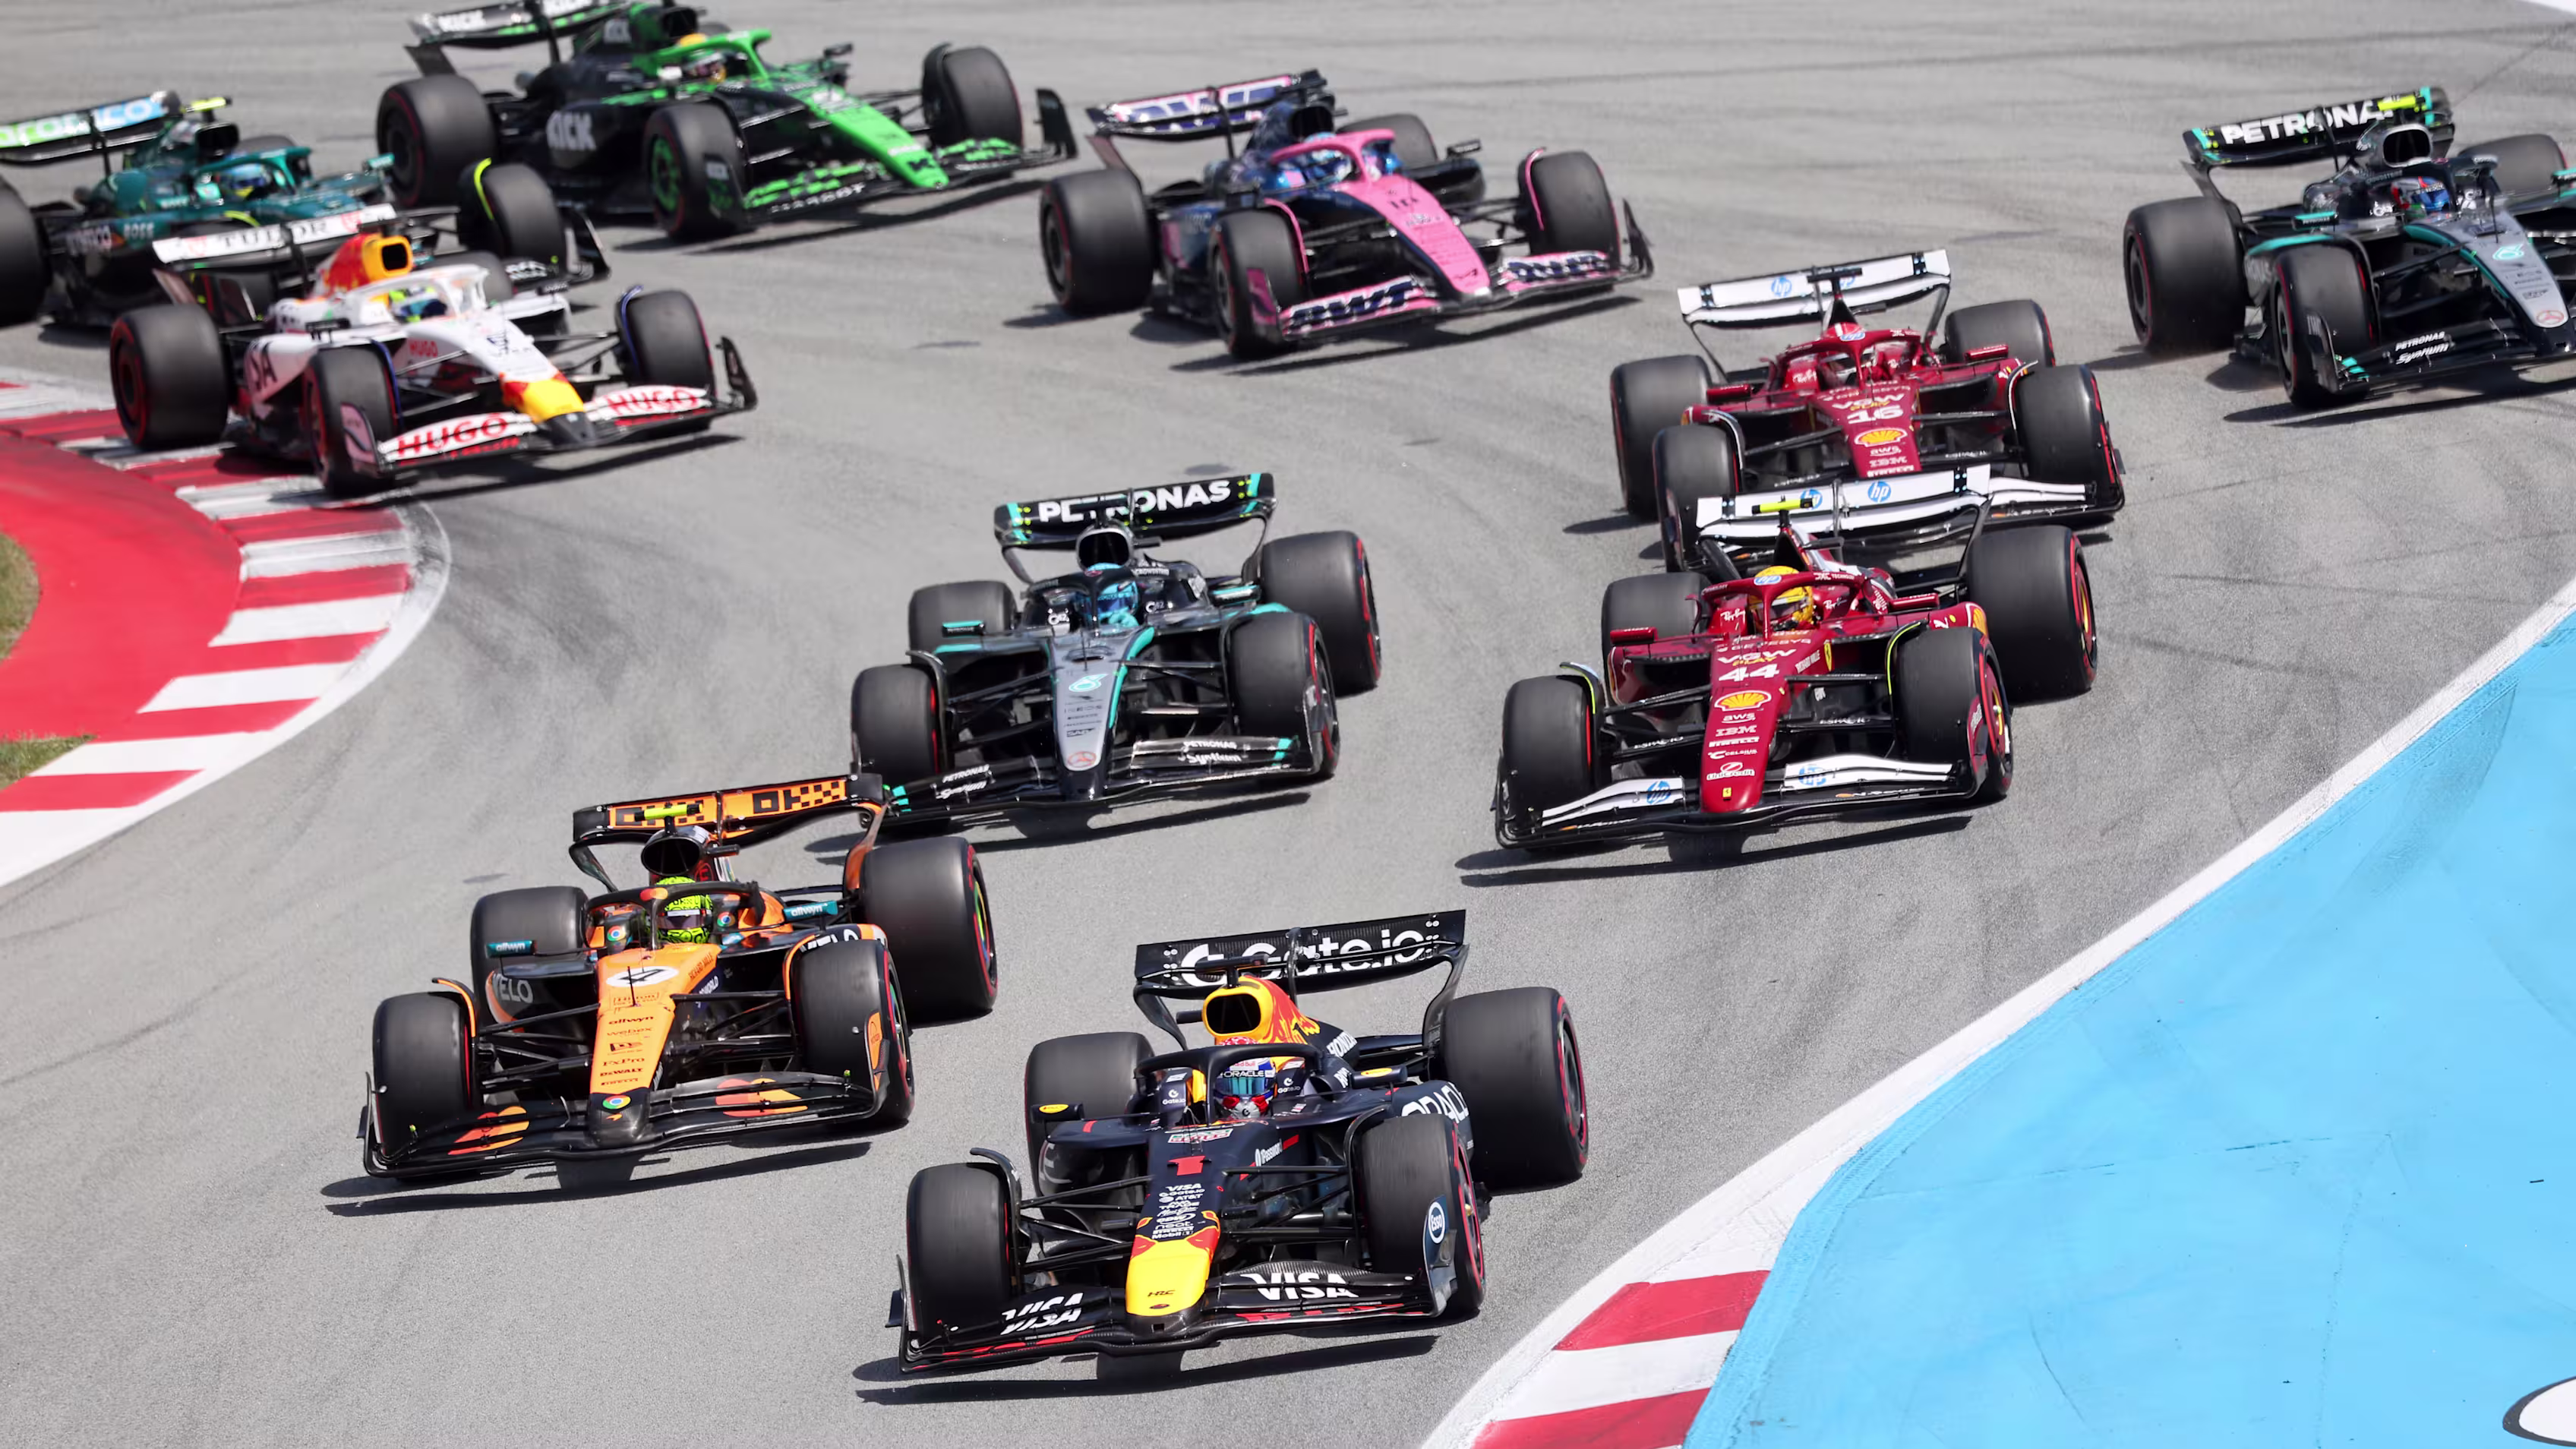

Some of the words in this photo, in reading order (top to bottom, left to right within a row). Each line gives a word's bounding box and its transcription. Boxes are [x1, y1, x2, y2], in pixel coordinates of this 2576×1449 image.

[2395, 331, 2445, 352] PETRONAS
[1846, 405, 1904, 424] 16
[395, 412, 509, 456] HUGO
[1867, 481, 1892, 503] hp
[1717, 649, 1797, 664] VGW
[1718, 663, 1779, 681] 44
[1722, 712, 1756, 721] aws
[1715, 724, 1757, 737] IBM
[1183, 741, 1237, 750] PETRONAS
[1186, 752, 1242, 765] Syntium
[942, 763, 990, 783] PETRONAS
[495, 942, 526, 952] allwyn
[492, 973, 533, 1004] VELO
[608, 1016, 654, 1024] allwyn
[1168, 1155, 1205, 1176] 1
[1166, 1183, 1201, 1192] VISA
[1240, 1272, 1359, 1301] VISA
[1000, 1293, 1084, 1335] VISA
